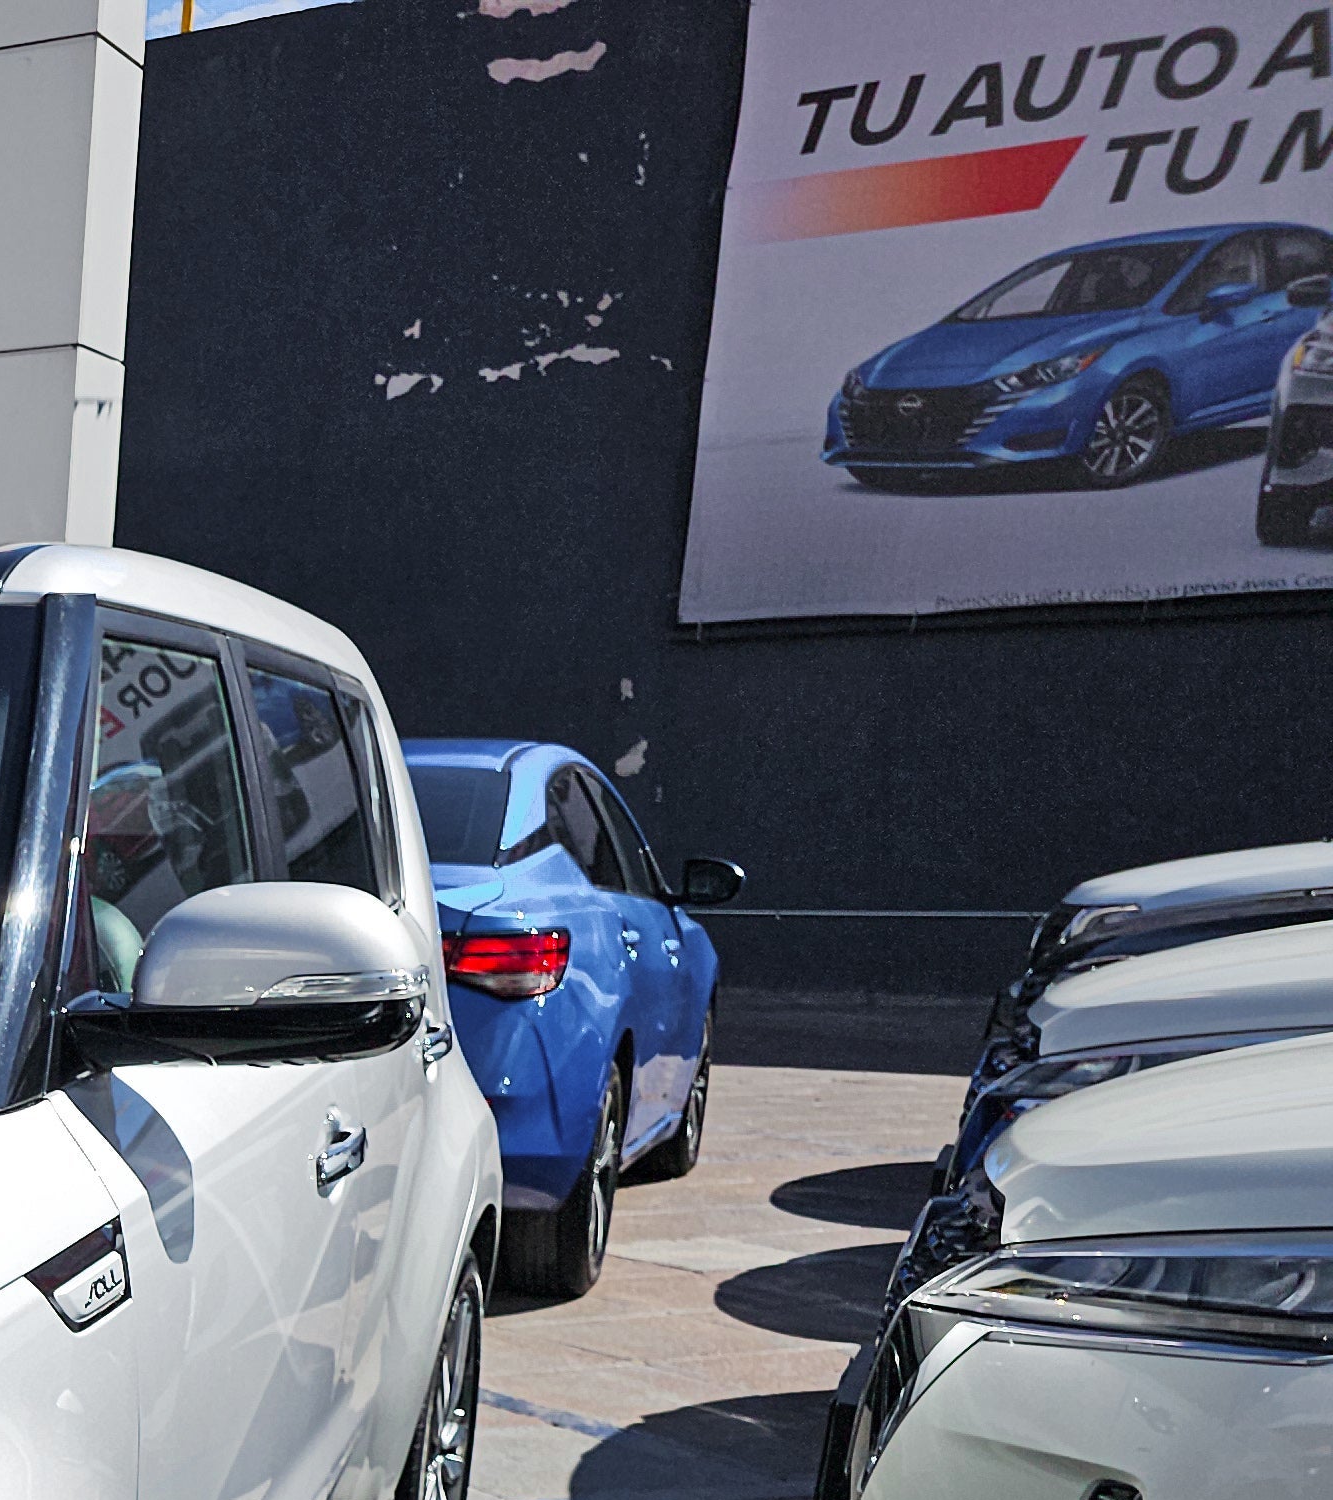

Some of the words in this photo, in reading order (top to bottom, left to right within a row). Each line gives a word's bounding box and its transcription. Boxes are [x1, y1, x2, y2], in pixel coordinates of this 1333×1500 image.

[797, 73, 926, 156] TU
[929, 26, 1238, 137] AUTO
[1104, 117, 1252, 205] TU
